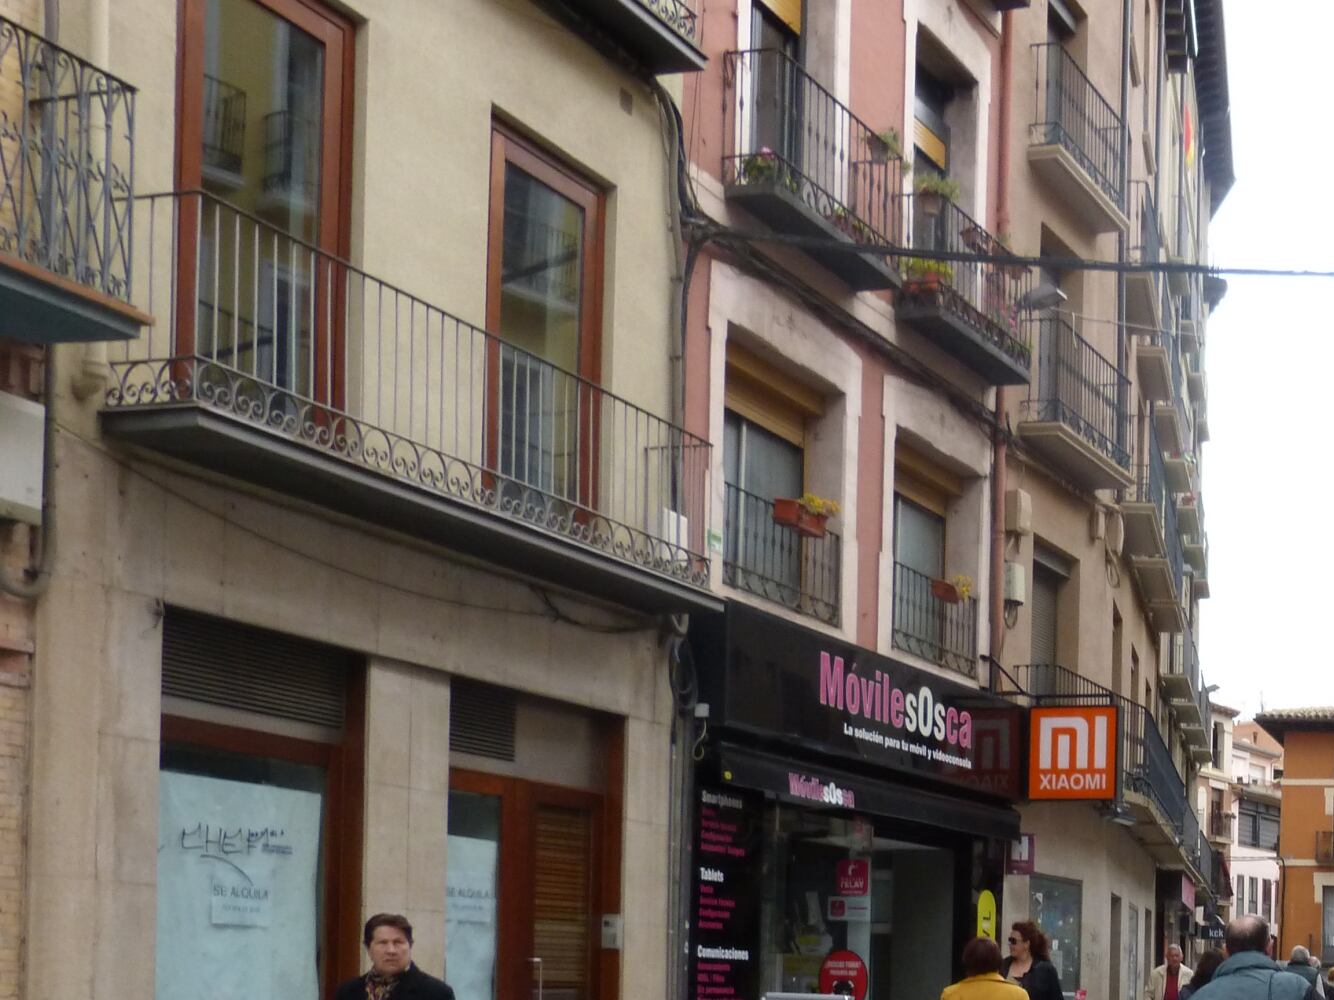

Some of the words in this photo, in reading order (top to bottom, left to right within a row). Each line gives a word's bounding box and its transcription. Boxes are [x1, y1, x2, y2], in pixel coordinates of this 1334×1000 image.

[844, 722, 853, 735] La
[854, 727, 884, 745] solución
[885, 738, 901, 750] para
[902, 740, 909, 751] tu
[910, 742, 927, 758] móvil
[927, 749, 932, 760] y
[1039, 773, 1107, 791] XIAOMI
[700, 867, 724, 883] Tablets
[230, 886, 268, 900] ALQUILA
[697, 945, 749, 960] Comunicaciones
